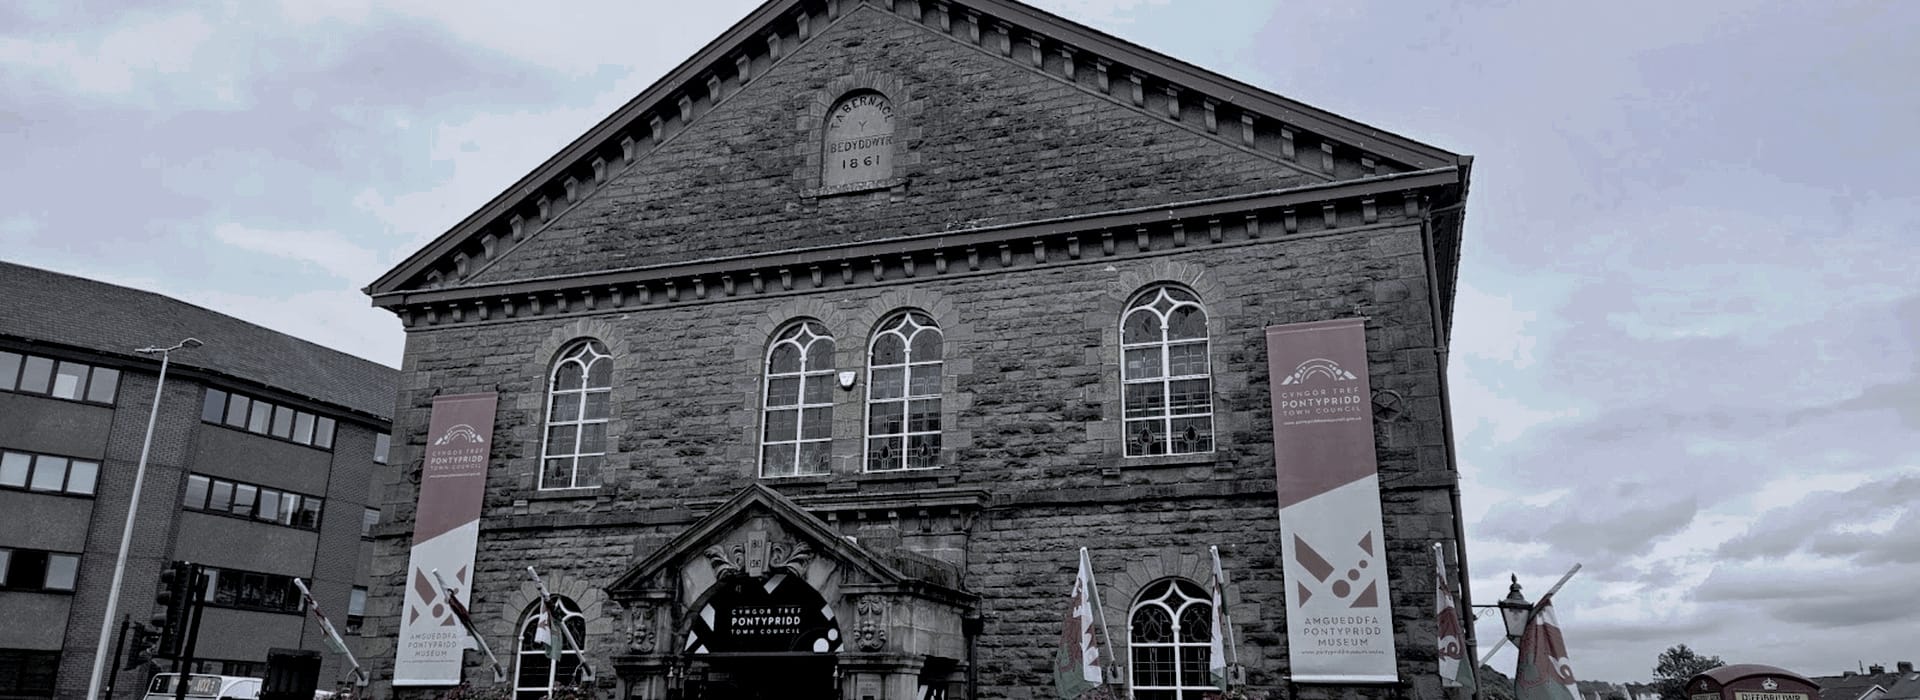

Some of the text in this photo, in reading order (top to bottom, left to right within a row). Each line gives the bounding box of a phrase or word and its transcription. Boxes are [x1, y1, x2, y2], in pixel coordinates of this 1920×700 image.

[859, 121, 868, 132] Y
[830, 136, 893, 153] BEDYDDWYR
[842, 155, 880, 169] 1861
[1282, 386, 1359, 398] CYNGOR TREF
[1282, 396, 1361, 408] PONTYPRIDD
[431, 455, 483, 464] PONTYPRIDD
[731, 616, 801, 626] PONTYPRIDD
[1304, 616, 1378, 625] AMGUEDDFA
[1303, 626, 1381, 636] PONTYPRIDD
[408, 641, 457, 649] PONTYPRIDD
[1318, 638, 1368, 646] MUSEUM
